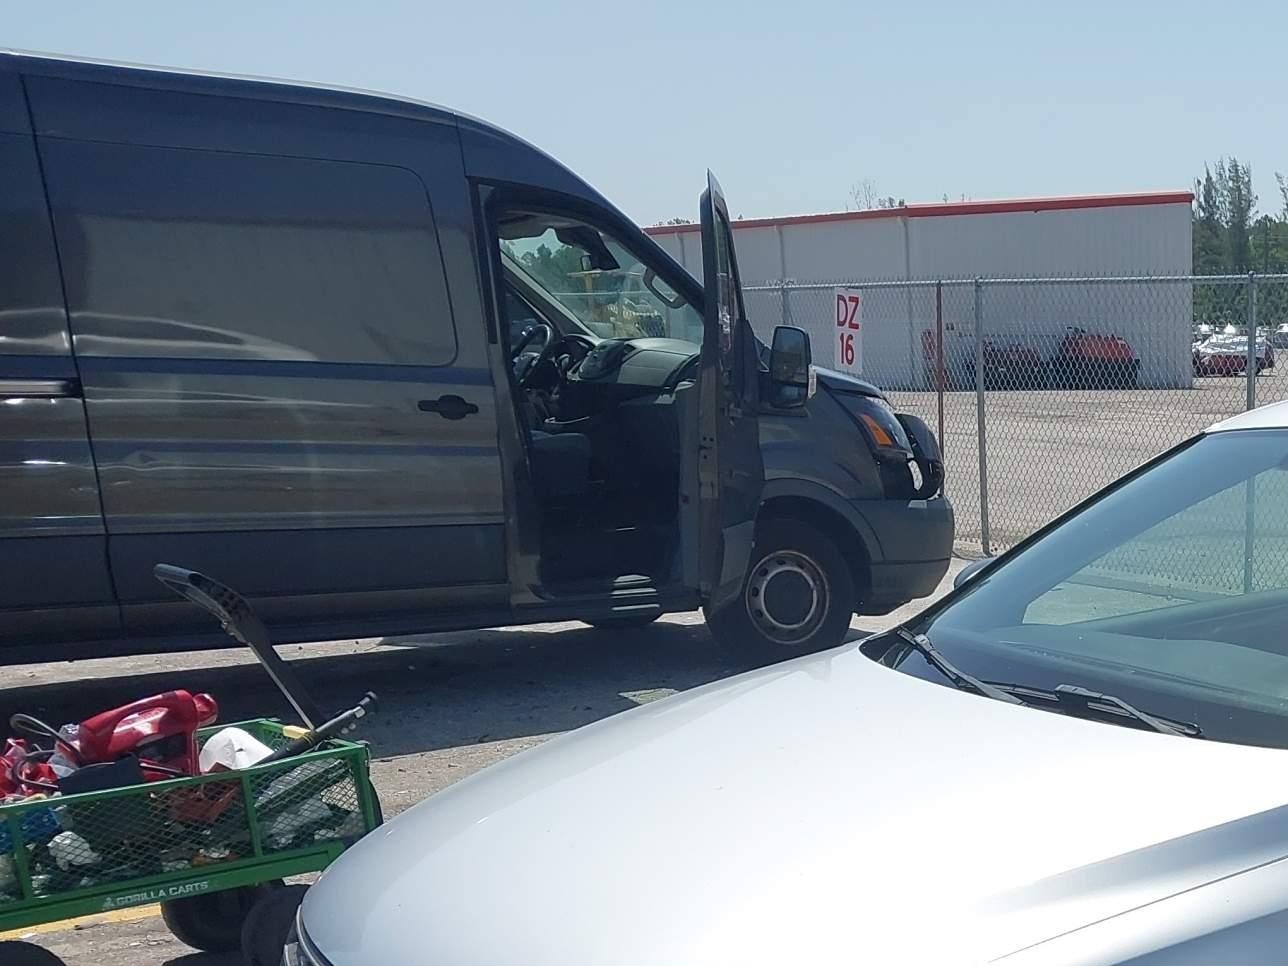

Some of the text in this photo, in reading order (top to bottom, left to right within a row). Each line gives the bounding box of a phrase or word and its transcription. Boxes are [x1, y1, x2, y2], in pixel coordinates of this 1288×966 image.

[836, 294, 860, 330] DZ
[840, 332, 854, 365] 16
[116, 881, 209, 906] GORILLA CARTS
